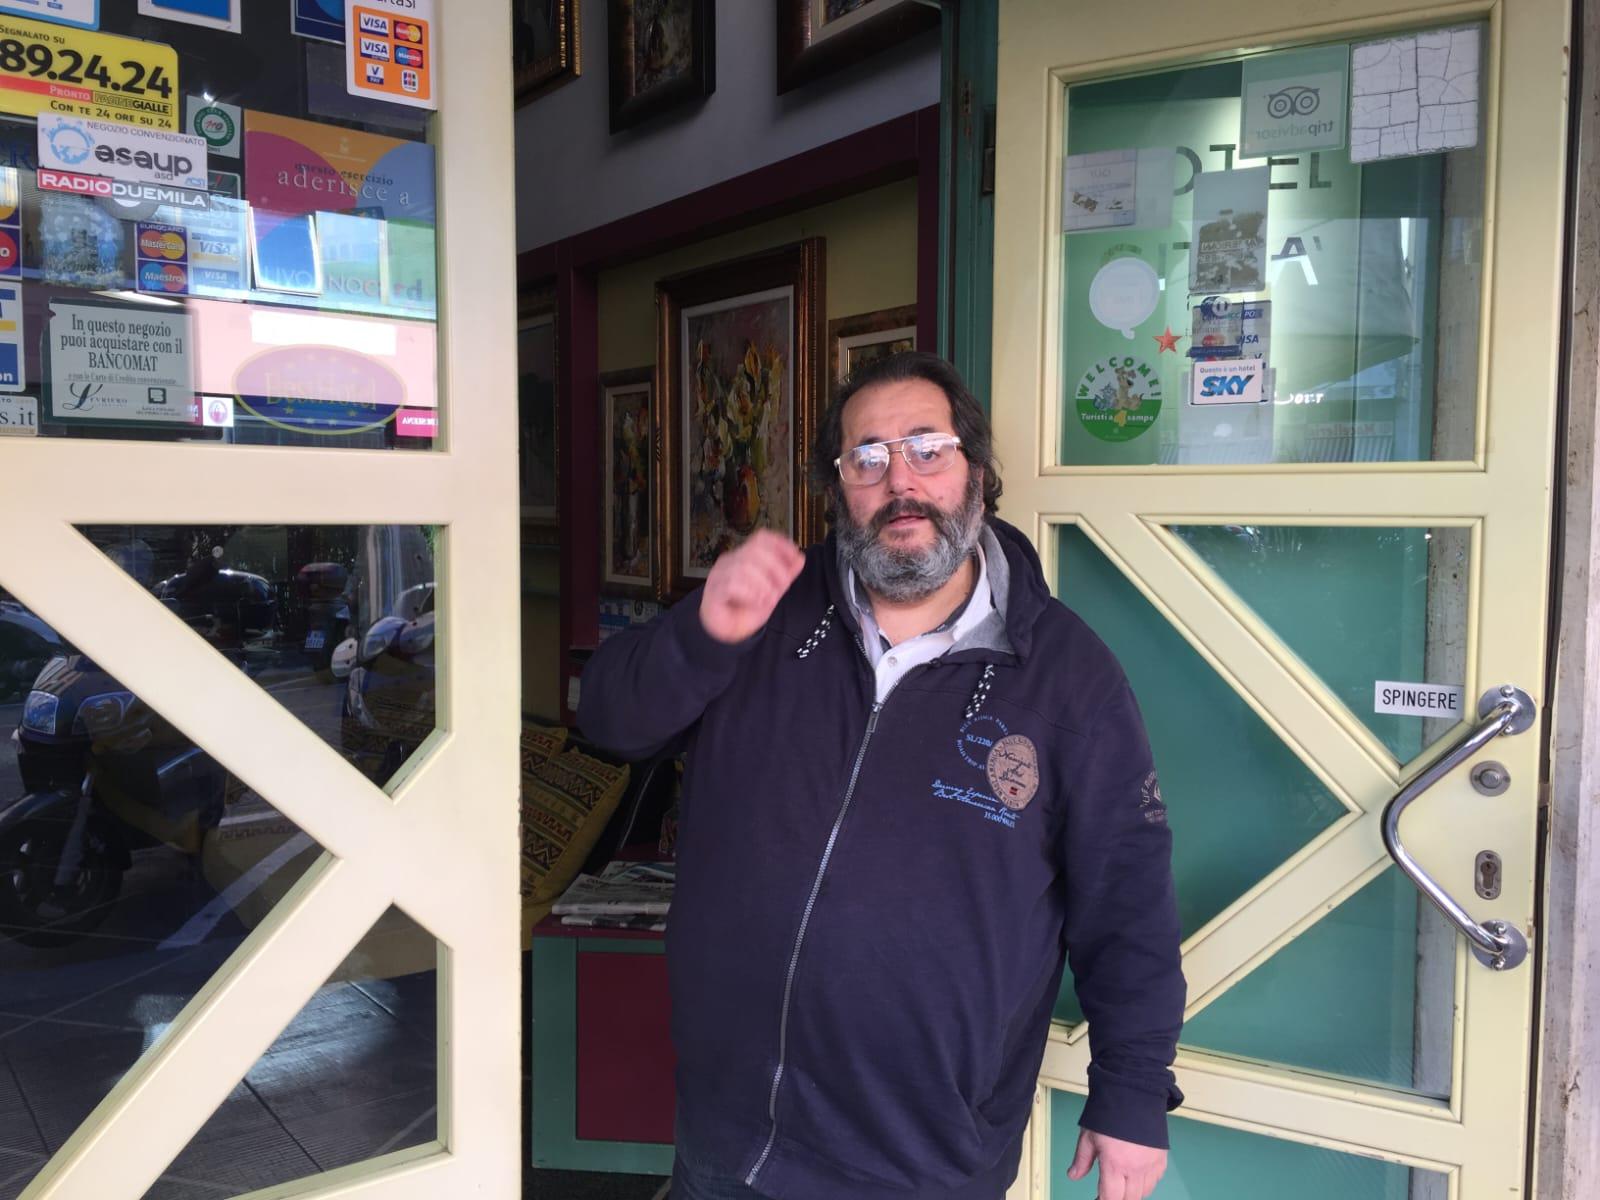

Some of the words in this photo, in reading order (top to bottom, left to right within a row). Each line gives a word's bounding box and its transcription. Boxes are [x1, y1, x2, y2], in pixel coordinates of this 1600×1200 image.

[363, 17, 388, 30] VISA
[53, 36, 65, 45] SU
[364, 41, 388, 55] VISA
[0, 39, 172, 99] 89.24.24
[80, 105, 91, 116] TE
[96, 107, 111, 120] 24
[114, 112, 135, 123] ORE
[139, 116, 154, 126] SU
[157, 117, 172, 129] 24
[86, 121, 129, 135] NEGOZIO
[130, 127, 205, 146] CONVENZIONATO
[94, 144, 192, 176] asaup
[154, 171, 174, 181] asd
[277, 166, 388, 202] aderisce
[399, 191, 409, 206] a
[340, 169, 394, 187] esercizio
[71, 313, 84, 331] In
[87, 316, 126, 336] questo
[128, 321, 171, 339] negozio
[61, 331, 87, 351] puoi
[89, 334, 150, 353] acquistare
[152, 341, 173, 354] con
[175, 338, 184, 355] il
[88, 352, 159, 373] BANCOMAT
[1200, 374, 1255, 397] SKY
[1382, 688, 1457, 710] SPINGERE
